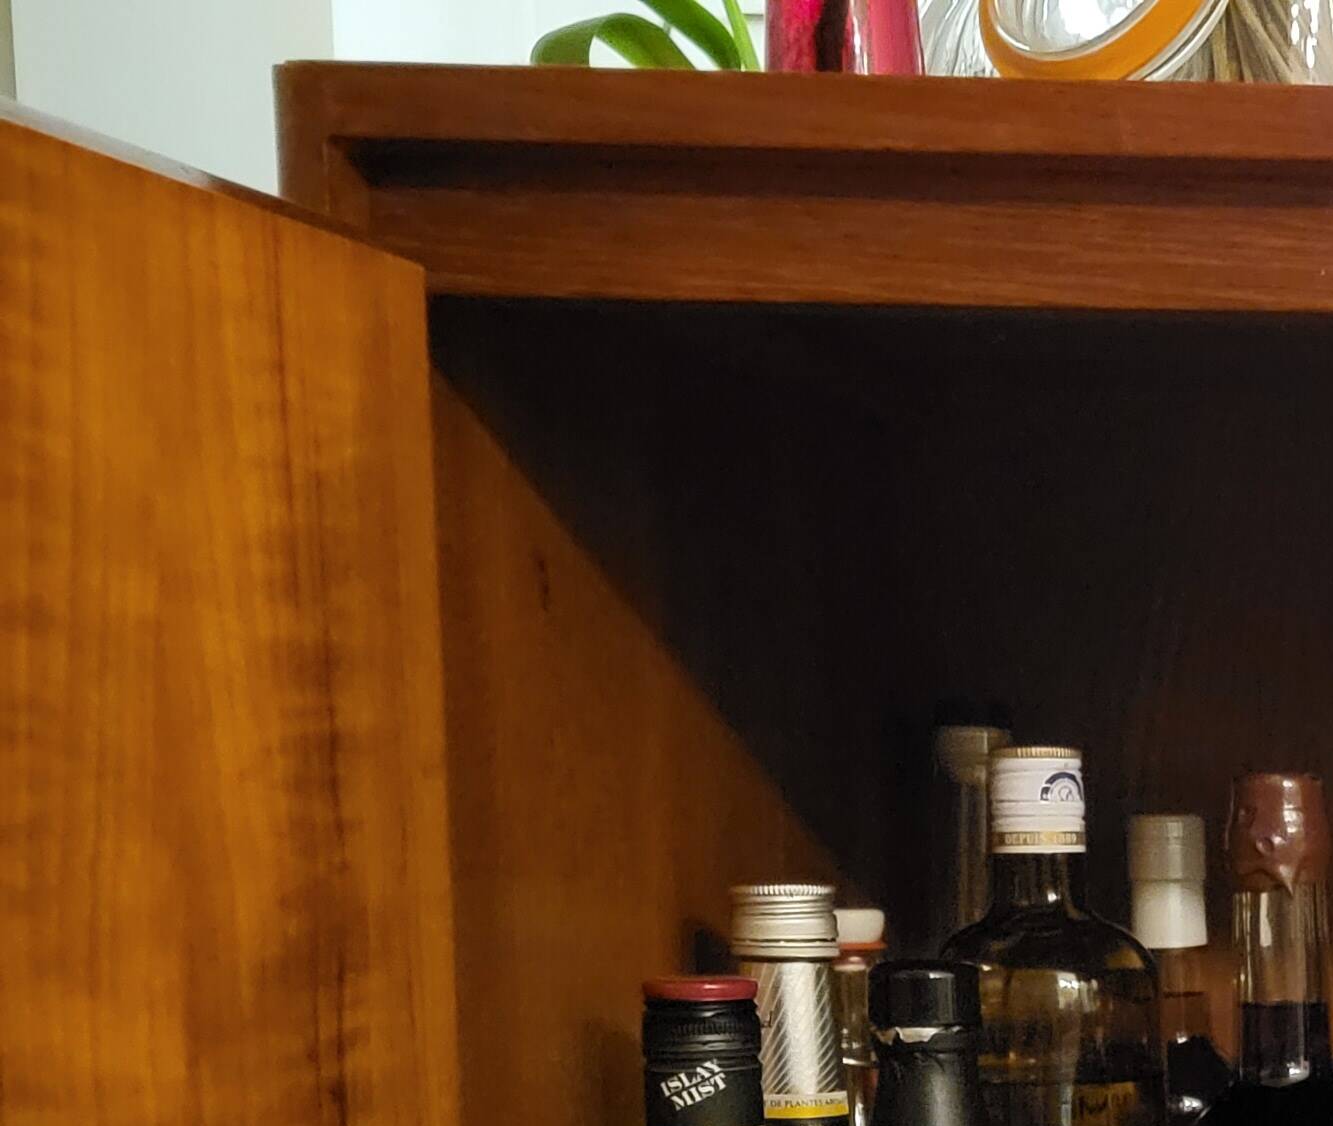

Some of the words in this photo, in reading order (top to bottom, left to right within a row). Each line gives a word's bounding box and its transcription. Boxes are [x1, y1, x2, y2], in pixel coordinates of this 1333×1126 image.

[1004, 831, 1048, 845] DEPUIS
[659, 1057, 723, 1097] ISLAY
[669, 1072, 727, 1112] MIST
